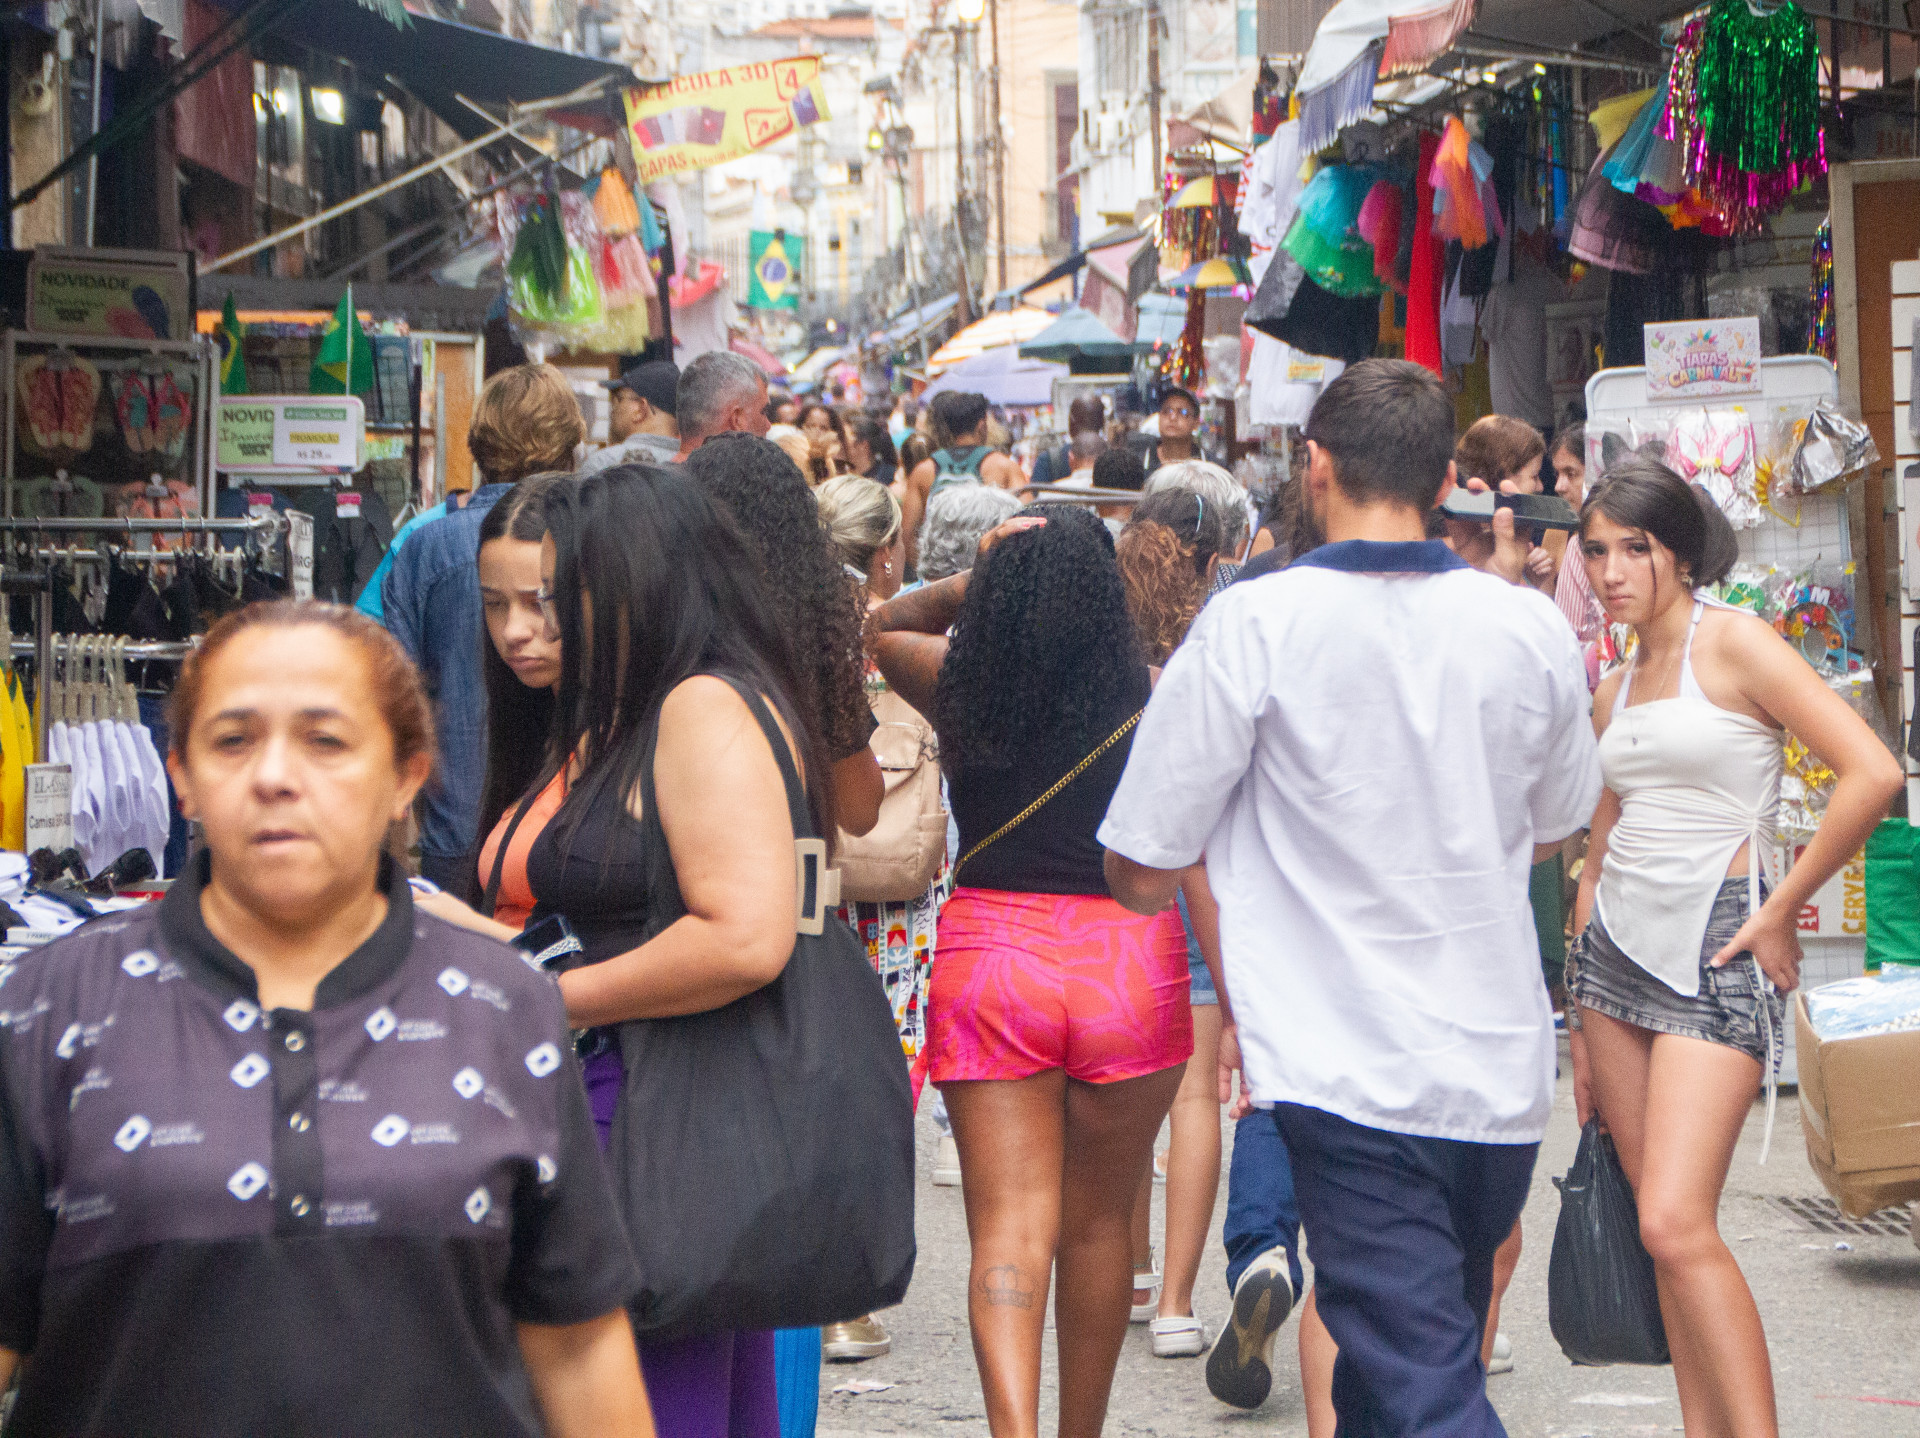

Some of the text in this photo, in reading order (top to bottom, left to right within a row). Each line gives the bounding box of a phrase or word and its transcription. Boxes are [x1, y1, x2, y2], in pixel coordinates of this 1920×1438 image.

[740, 62, 769, 84] 3D
[637, 153, 688, 181] CAPAS
[41, 271, 130, 291] NOVIDADE
[1675, 351, 1729, 370] TIARAS
[1668, 366, 1738, 388] CARNAVAL
